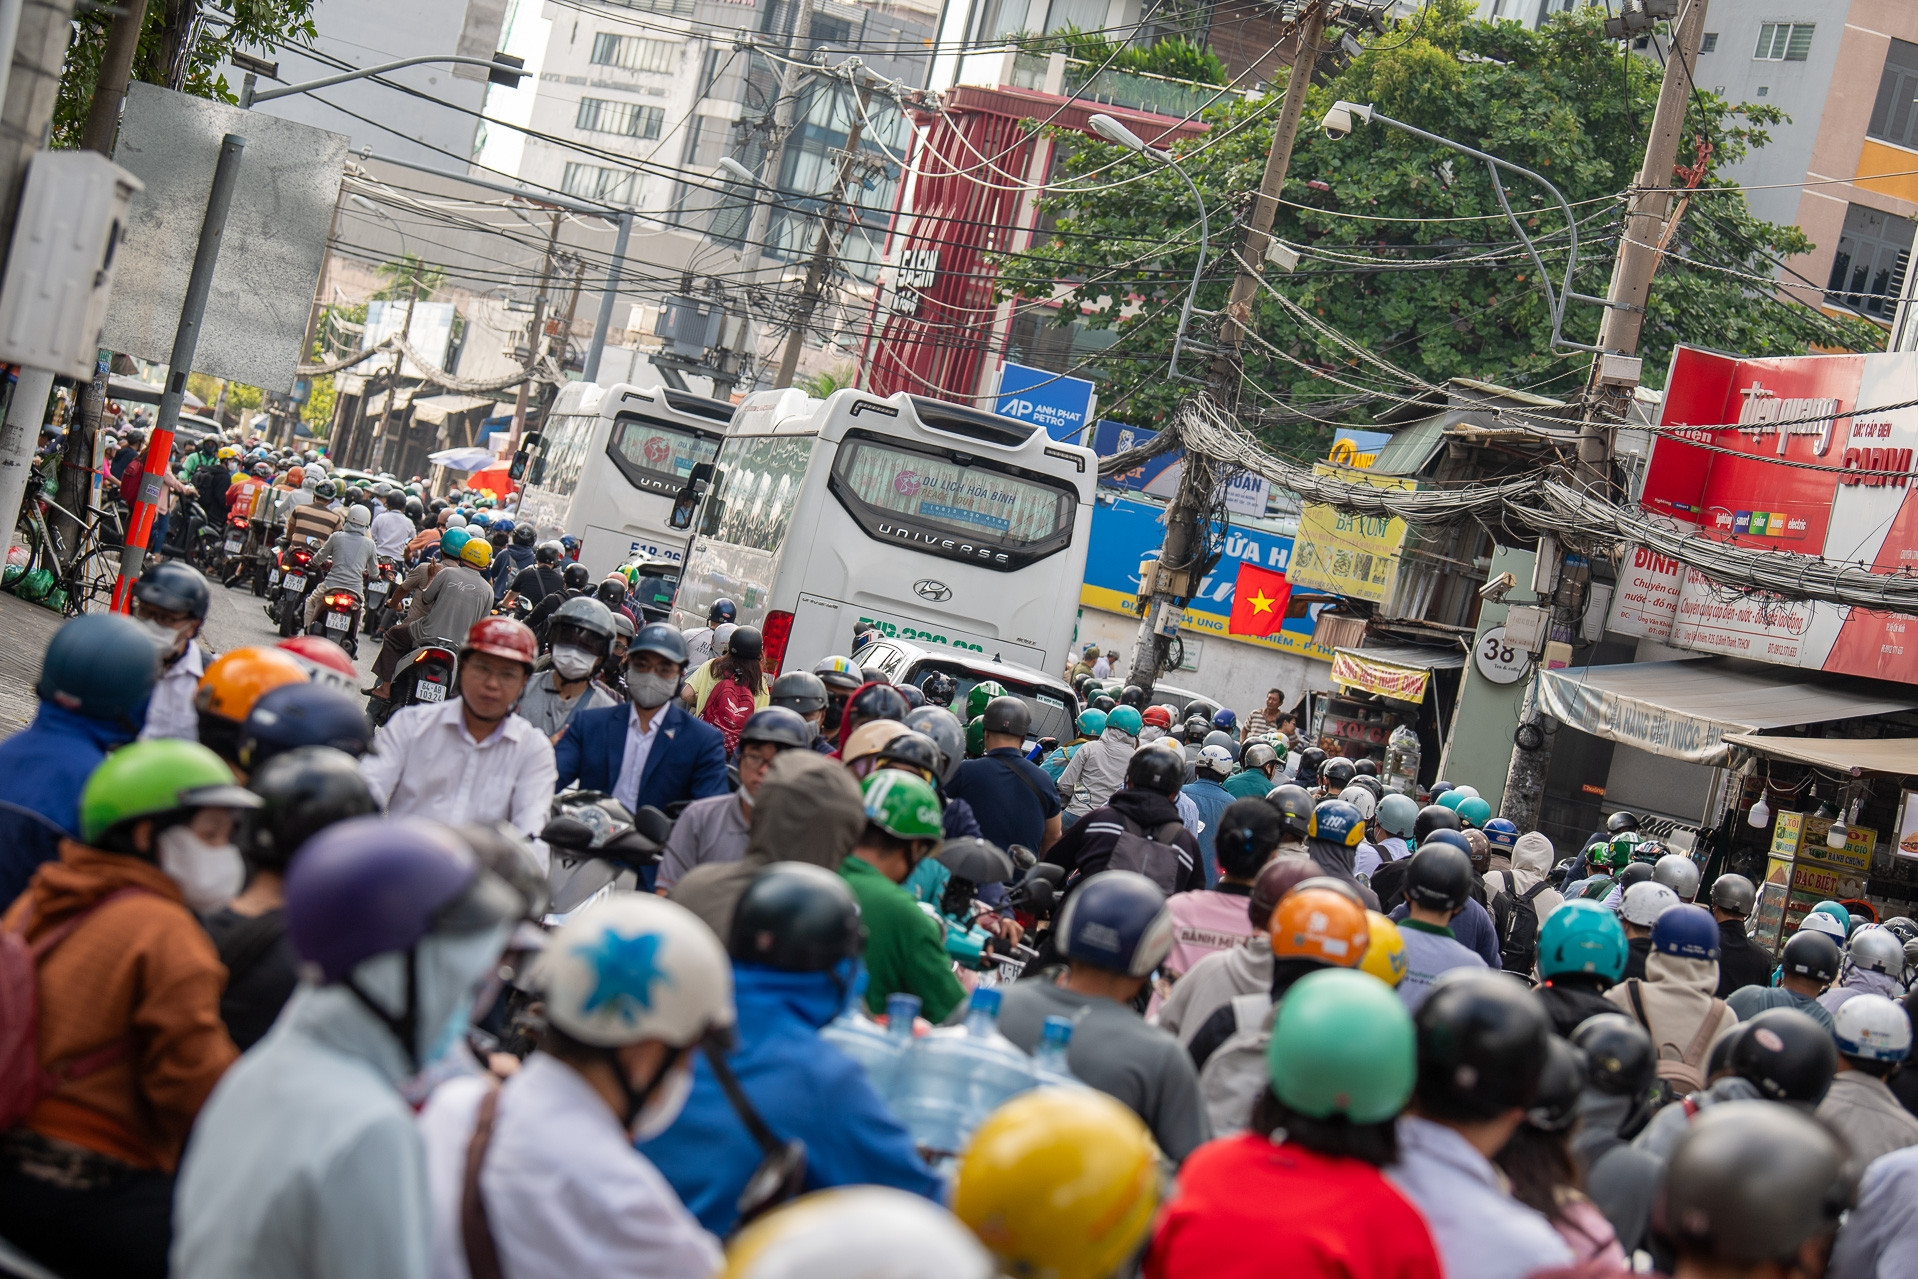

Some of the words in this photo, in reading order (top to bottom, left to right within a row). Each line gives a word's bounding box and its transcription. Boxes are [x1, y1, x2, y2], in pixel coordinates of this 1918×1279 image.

[1001, 399, 1033, 417] AP
[1035, 404, 1056, 416] ANH
[1057, 409, 1081, 421] PHAT
[1033, 413, 1065, 427] PETRO
[923, 477, 938, 488] DU
[941, 479, 964, 492] LỊCH
[967, 484, 988, 499] HÒA
[1715, 512, 1733, 528] lighting
[1735, 515, 1750, 527] smart
[1753, 516, 1767, 528] solar
[1769, 517, 1784, 529] home
[1787, 518, 1807, 531] electric
[878, 523, 1010, 565] UNIVERSE
[1633, 577, 1666, 593] Chuyên
[1624, 592, 1646, 604] nước
[1484, 638, 1515, 663] 38
[1333, 719, 1367, 741] XÔI
[1624, 702, 1650, 741] HÀNG
[1670, 716, 1700, 753] NƯỚC
[1794, 869, 1815, 889] ĐẶC
[1815, 871, 1837, 893] BIỆT
